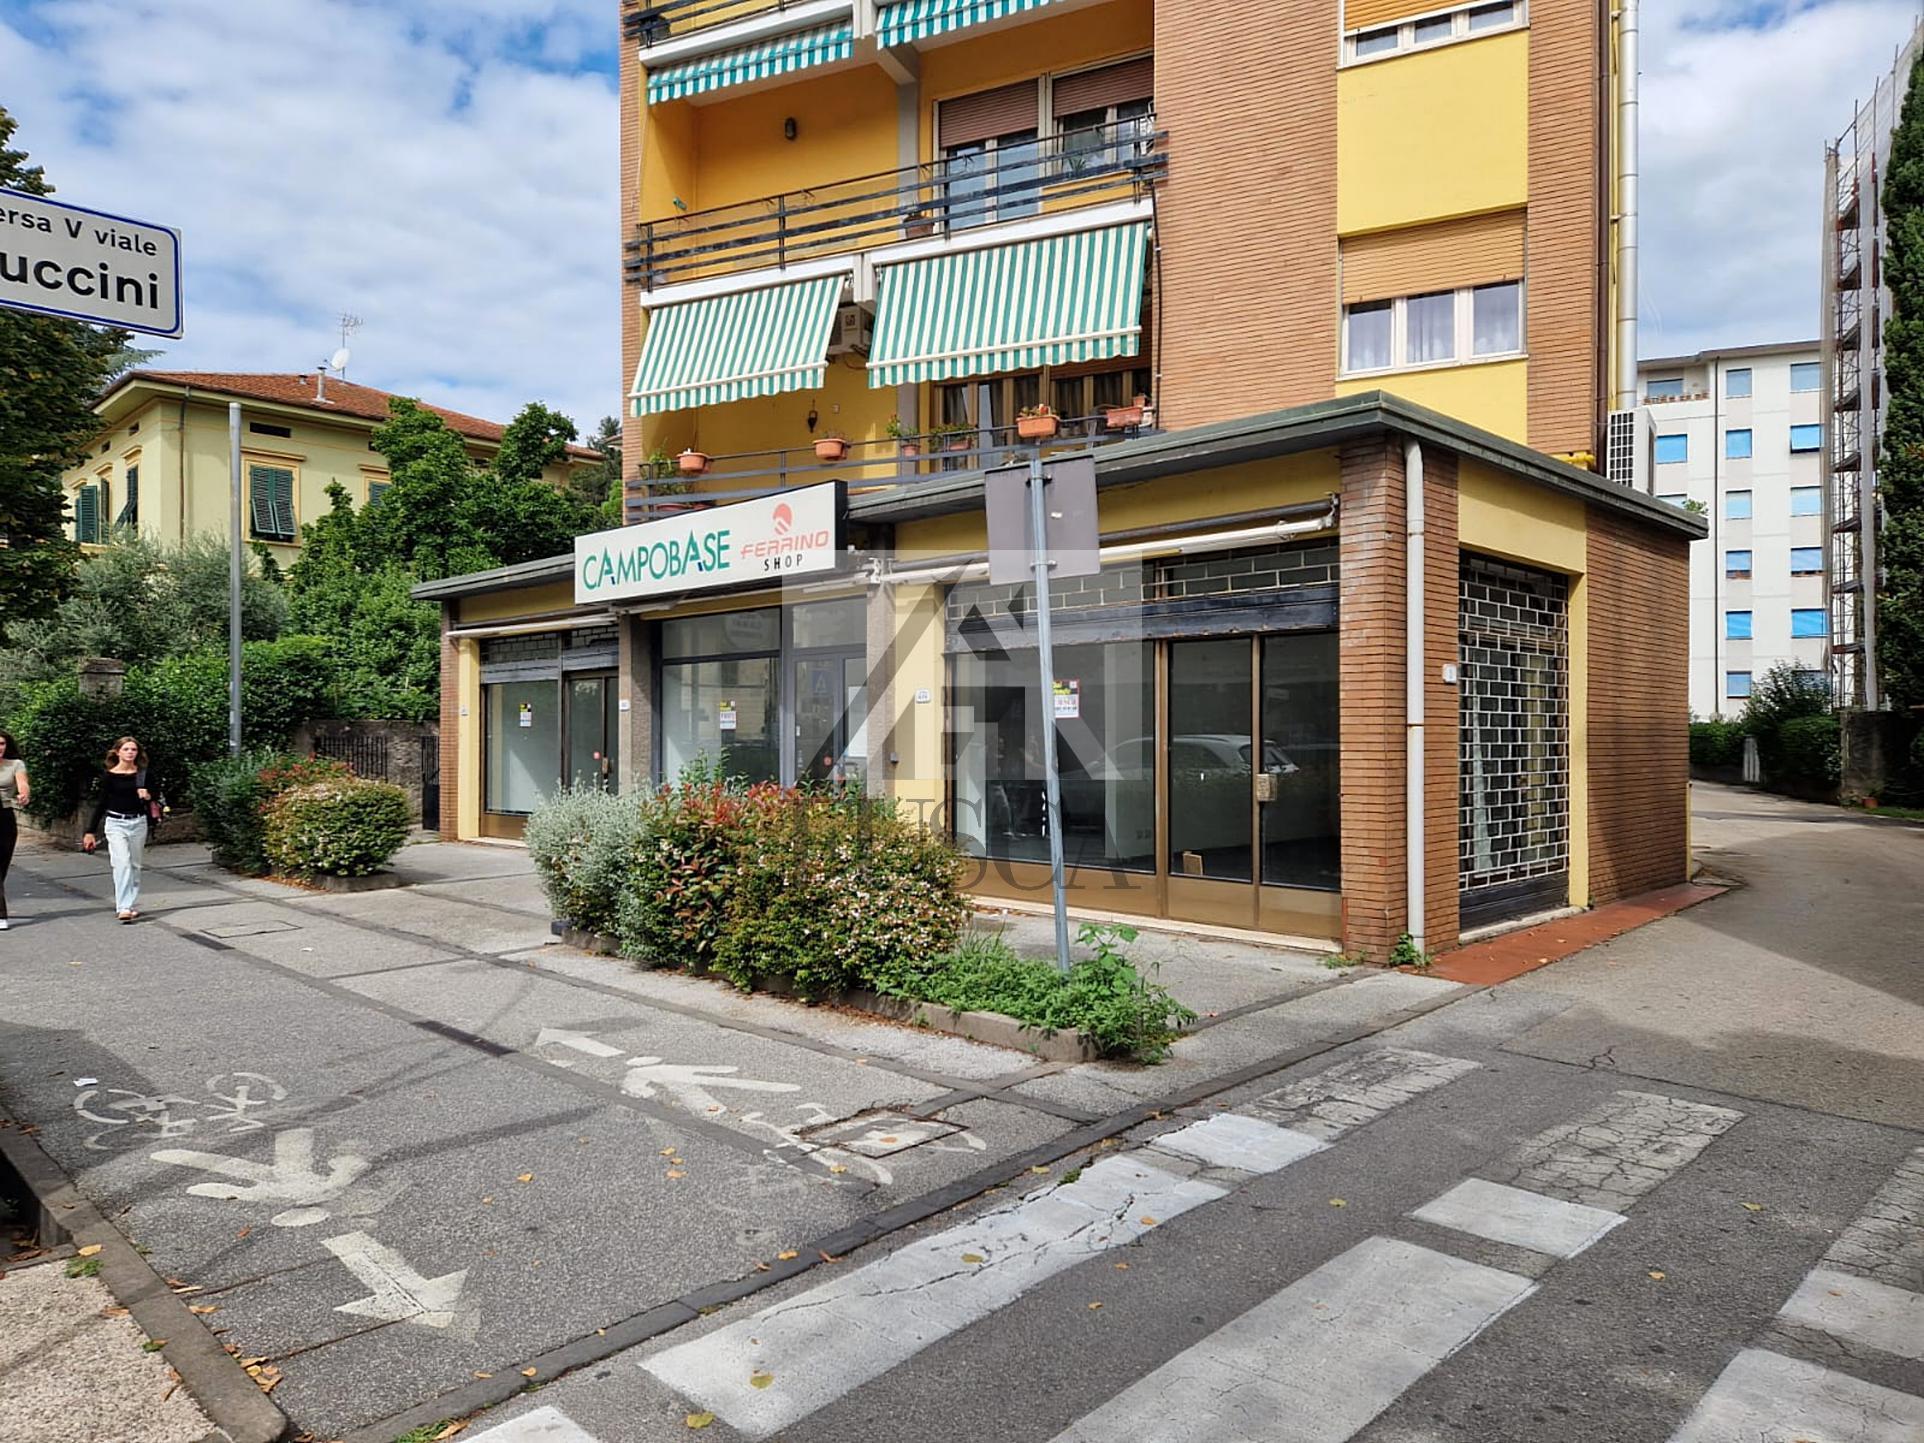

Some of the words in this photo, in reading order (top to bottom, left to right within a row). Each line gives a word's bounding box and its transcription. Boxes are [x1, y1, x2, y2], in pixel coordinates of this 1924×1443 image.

[64, 218, 83, 239] V
[94, 228, 157, 256] viale
[0, 251, 159, 310] uccini
[583, 529, 730, 590] CAMPOBASE
[741, 530, 829, 559] FERRINO
[764, 553, 804, 572] SHOP
